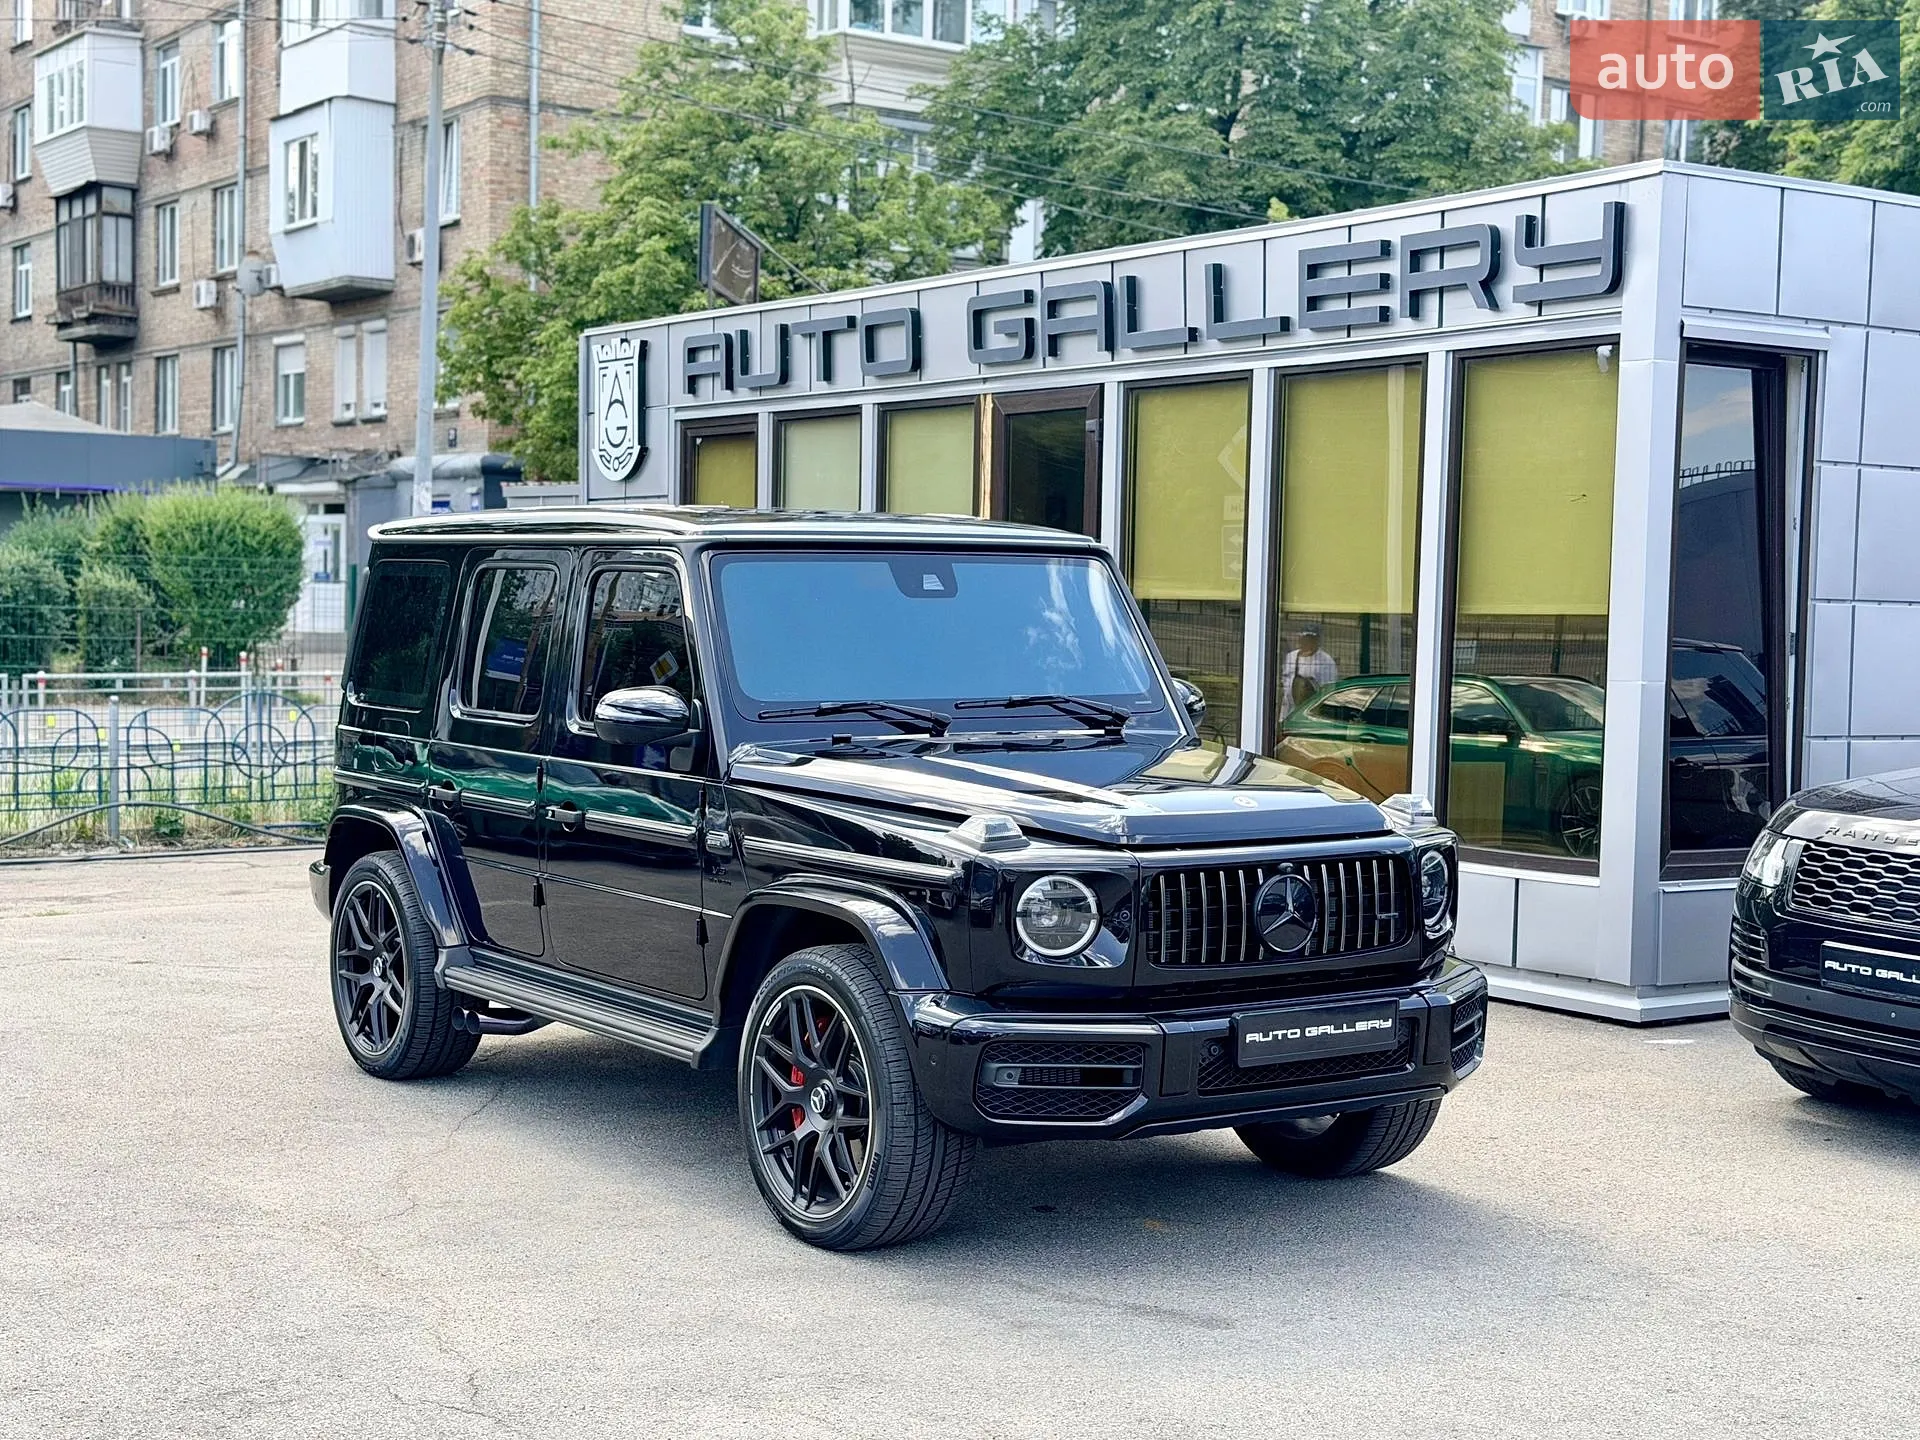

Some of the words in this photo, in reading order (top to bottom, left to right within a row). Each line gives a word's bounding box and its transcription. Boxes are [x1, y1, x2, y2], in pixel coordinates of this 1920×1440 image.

[682, 306, 922, 396] AUTO
[966, 200, 1626, 365] GALLERY
[1824, 826, 1920, 846] RANGE
[1824, 960, 1873, 976] AUTO
[1245, 1027, 1301, 1044] AUTO
[1305, 1018, 1392, 1037] GALLERY
